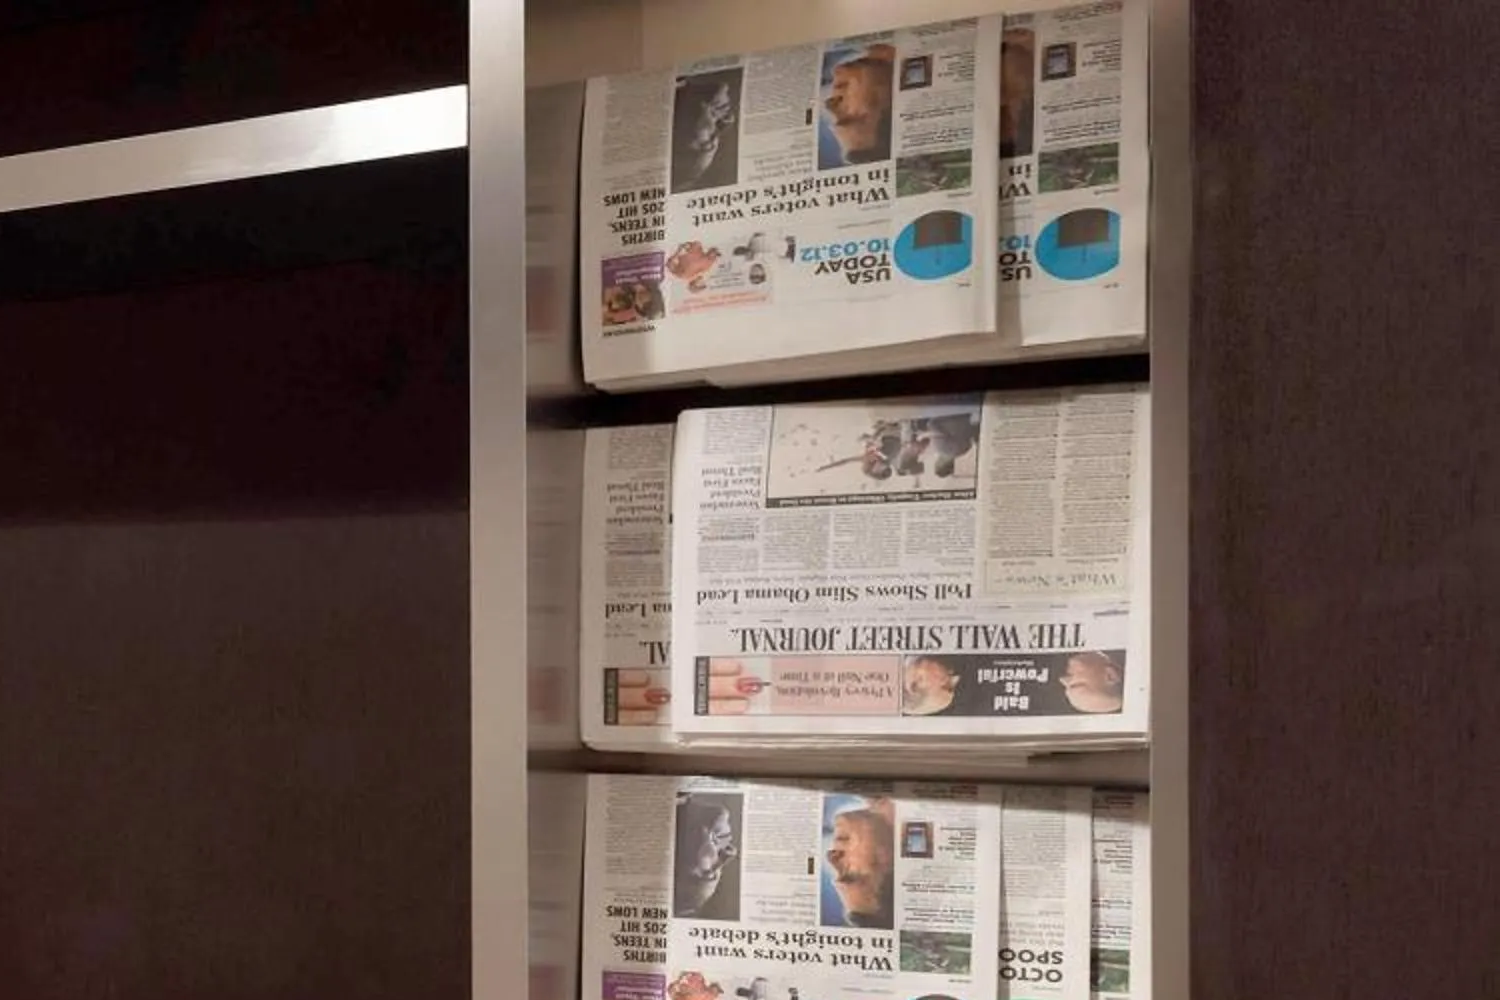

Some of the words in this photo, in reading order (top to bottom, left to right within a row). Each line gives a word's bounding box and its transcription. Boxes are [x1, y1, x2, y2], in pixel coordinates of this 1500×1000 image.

[868, 168, 890, 184] in
[763, 174, 859, 198] tonight's
[602, 191, 635, 206] LOWS
[640, 187, 666, 202] NEW
[686, 190, 756, 211] debate
[821, 188, 890, 208] What
[617, 206, 638, 218] HIT
[751, 197, 819, 217] voters
[652, 216, 665, 229] IN
[692, 208, 744, 227] want
[621, 230, 664, 246] BIRTHS
[801, 239, 891, 261] 10.03.12
[814, 254, 890, 275] TODAY
[846, 268, 890, 285] USA
[1000, 266, 1032, 283] US
[696, 589, 739, 606] Lead
[744, 587, 810, 604] Obama
[814, 586, 860, 602] Slim
[865, 584, 928, 601] Shows
[934, 583, 972, 600] Poll
[605, 603, 646, 619] Lead
[846, 624, 943, 652] STREET
[949, 624, 1020, 650] WALL
[1028, 624, 1084, 649] THE
[977, 667, 1048, 683] Powerful
[1004, 682, 1020, 694] Is
[995, 695, 1028, 710] Bald
[606, 905, 638, 918] LOWS
[642, 906, 668, 920] NEW
[620, 920, 640, 933] HIT
[653, 936, 668, 949] IN
[688, 926, 760, 947] debate
[765, 930, 862, 952] tonight's
[870, 937, 893, 952] in
[623, 950, 667, 964] BIRTHS
[696, 944, 748, 960] want
[752, 947, 823, 964] voters
[998, 948, 1064, 964] SPOO
[832, 952, 893, 971] What
[1000, 966, 1063, 982] OCTO
